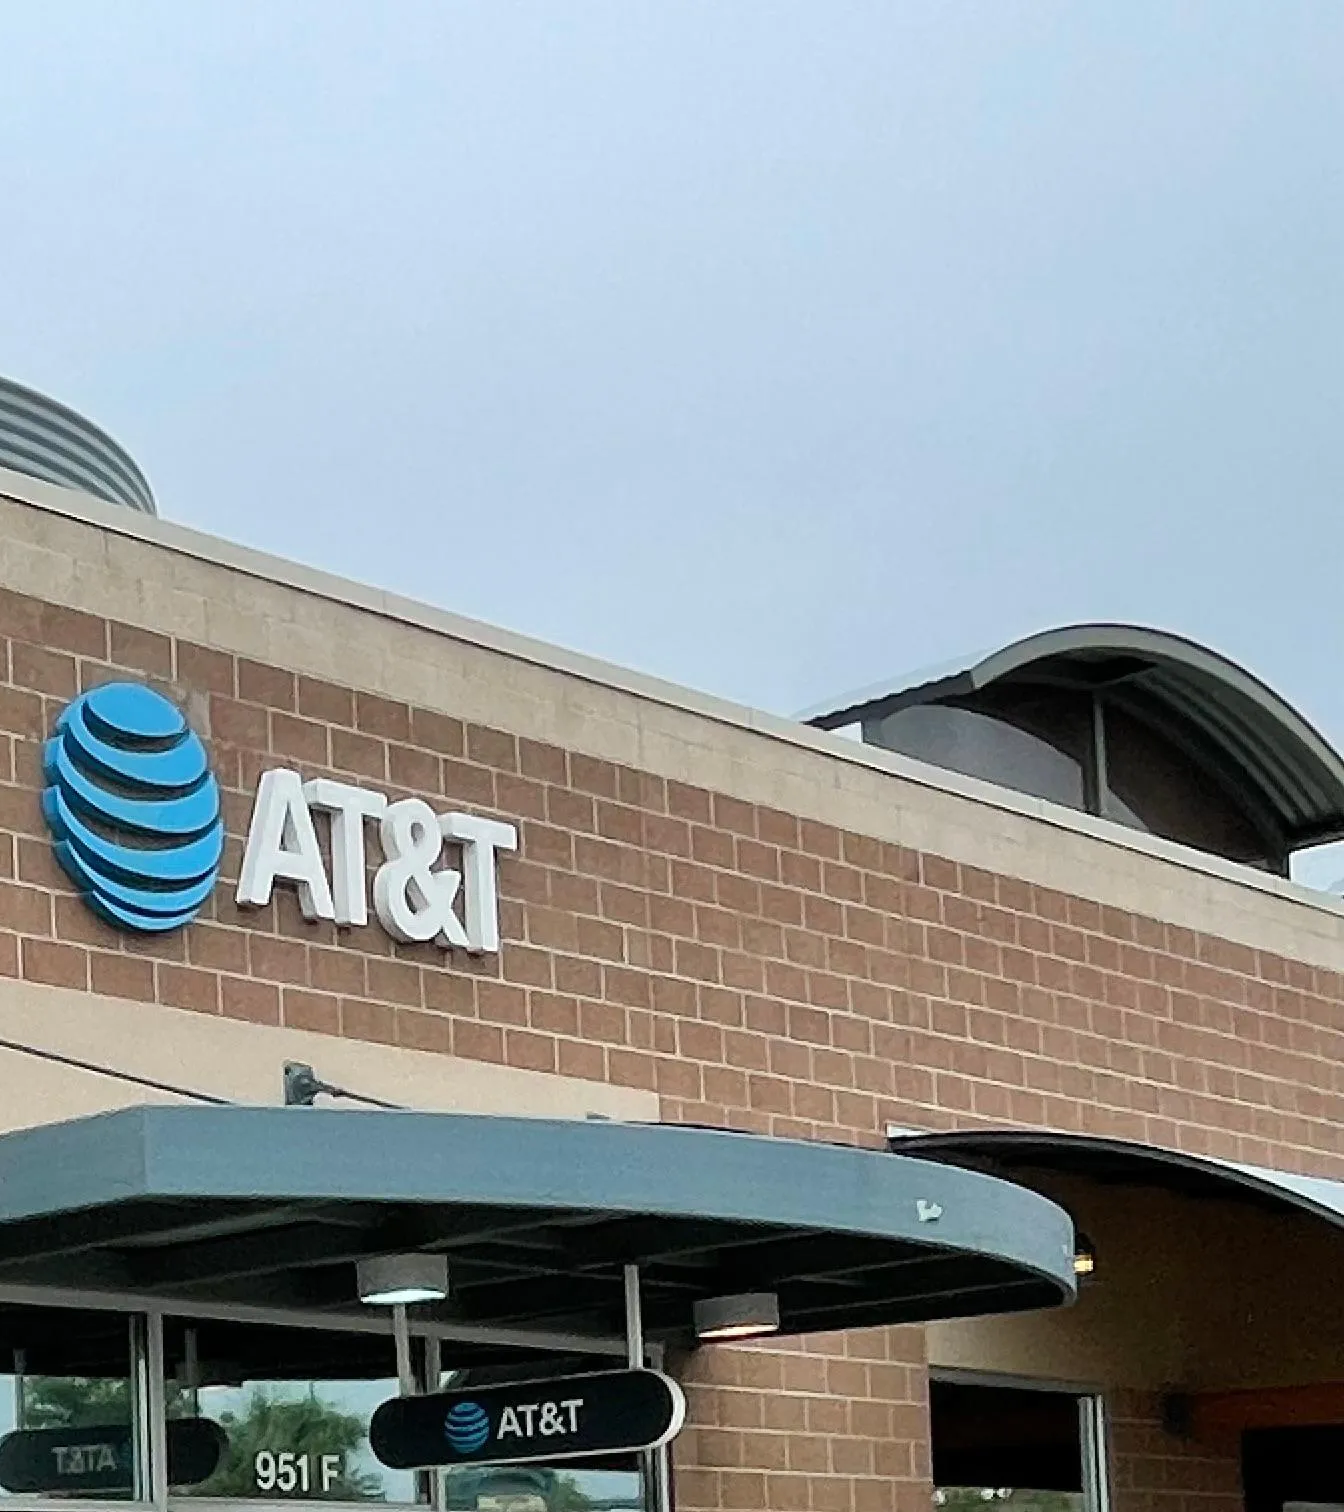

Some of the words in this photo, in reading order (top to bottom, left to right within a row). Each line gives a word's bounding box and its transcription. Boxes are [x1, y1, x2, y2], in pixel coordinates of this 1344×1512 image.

[235, 768, 518, 953] AT&T
[496, 1398, 584, 1440] AT&T
[255, 1450, 309, 1491] 951
[322, 1454, 340, 1491] F
